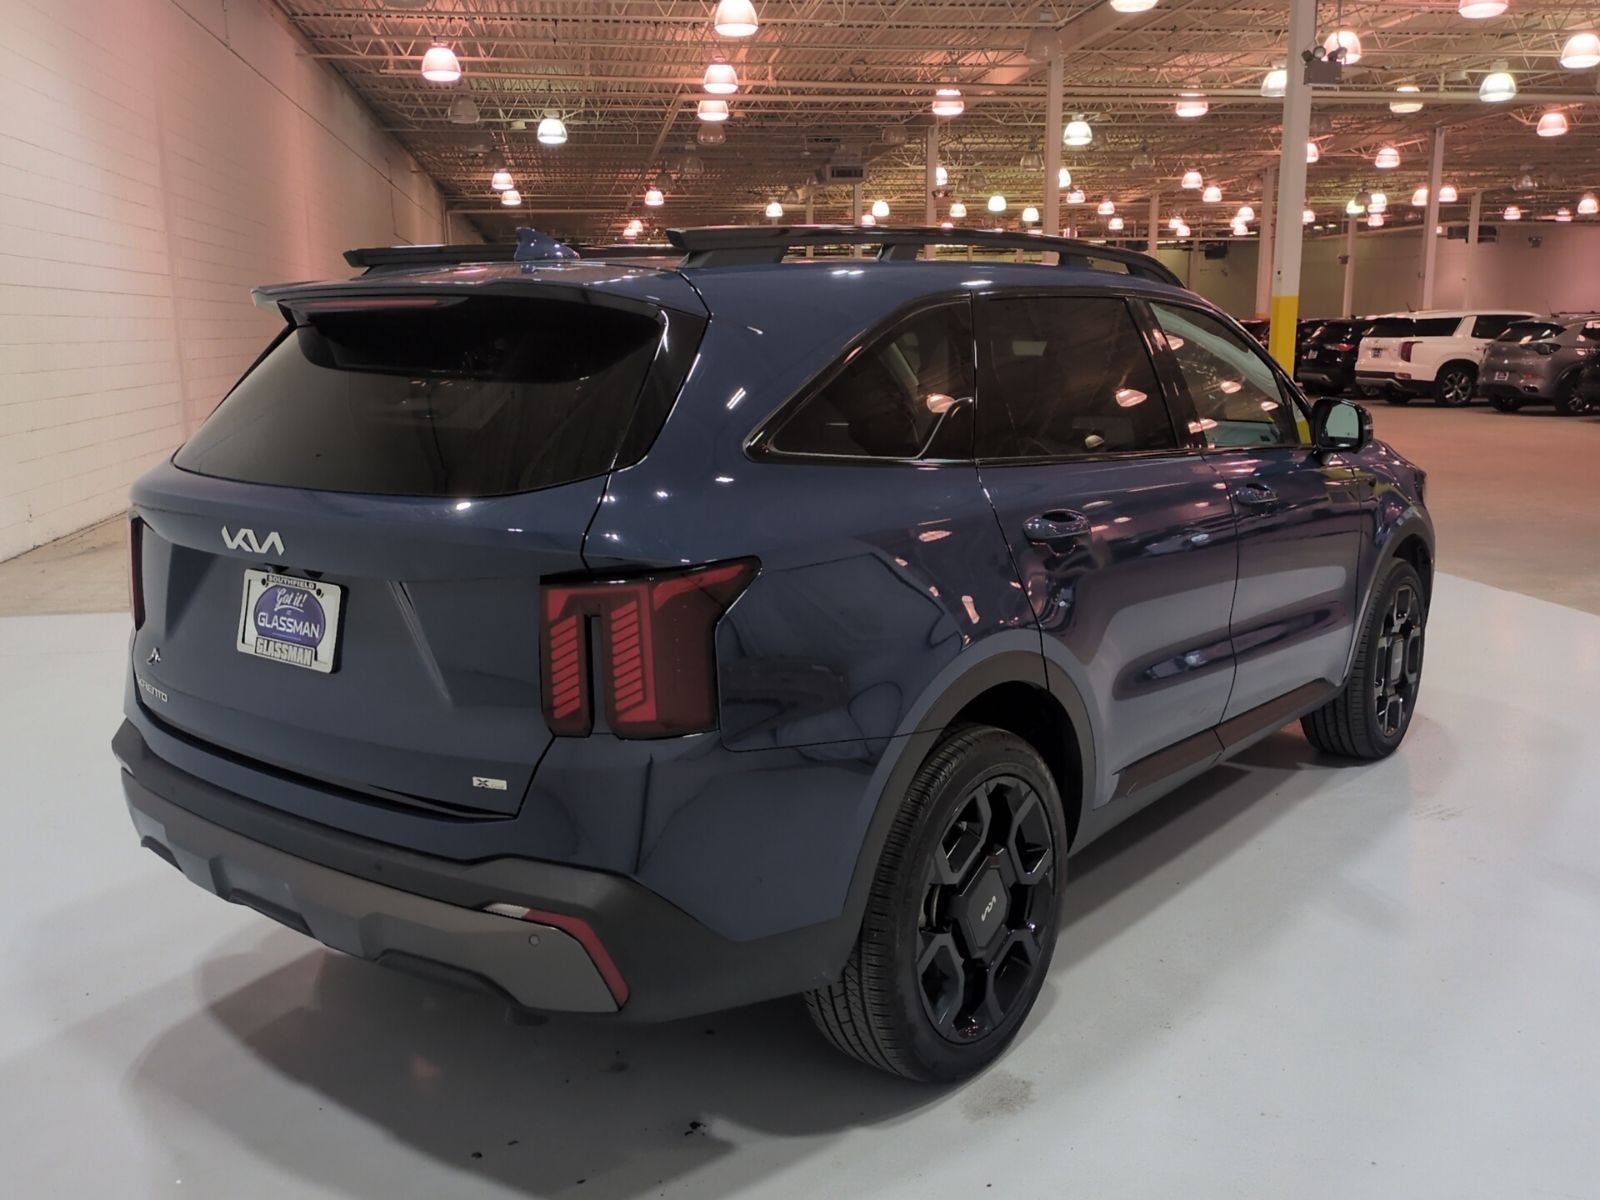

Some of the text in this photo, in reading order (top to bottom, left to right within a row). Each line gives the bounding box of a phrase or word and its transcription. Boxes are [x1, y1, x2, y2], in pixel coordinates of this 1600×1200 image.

[221, 525, 285, 556] KIA
[257, 612, 320, 638] GLASSMAN
[256, 638, 313, 667] GLASSMAN
